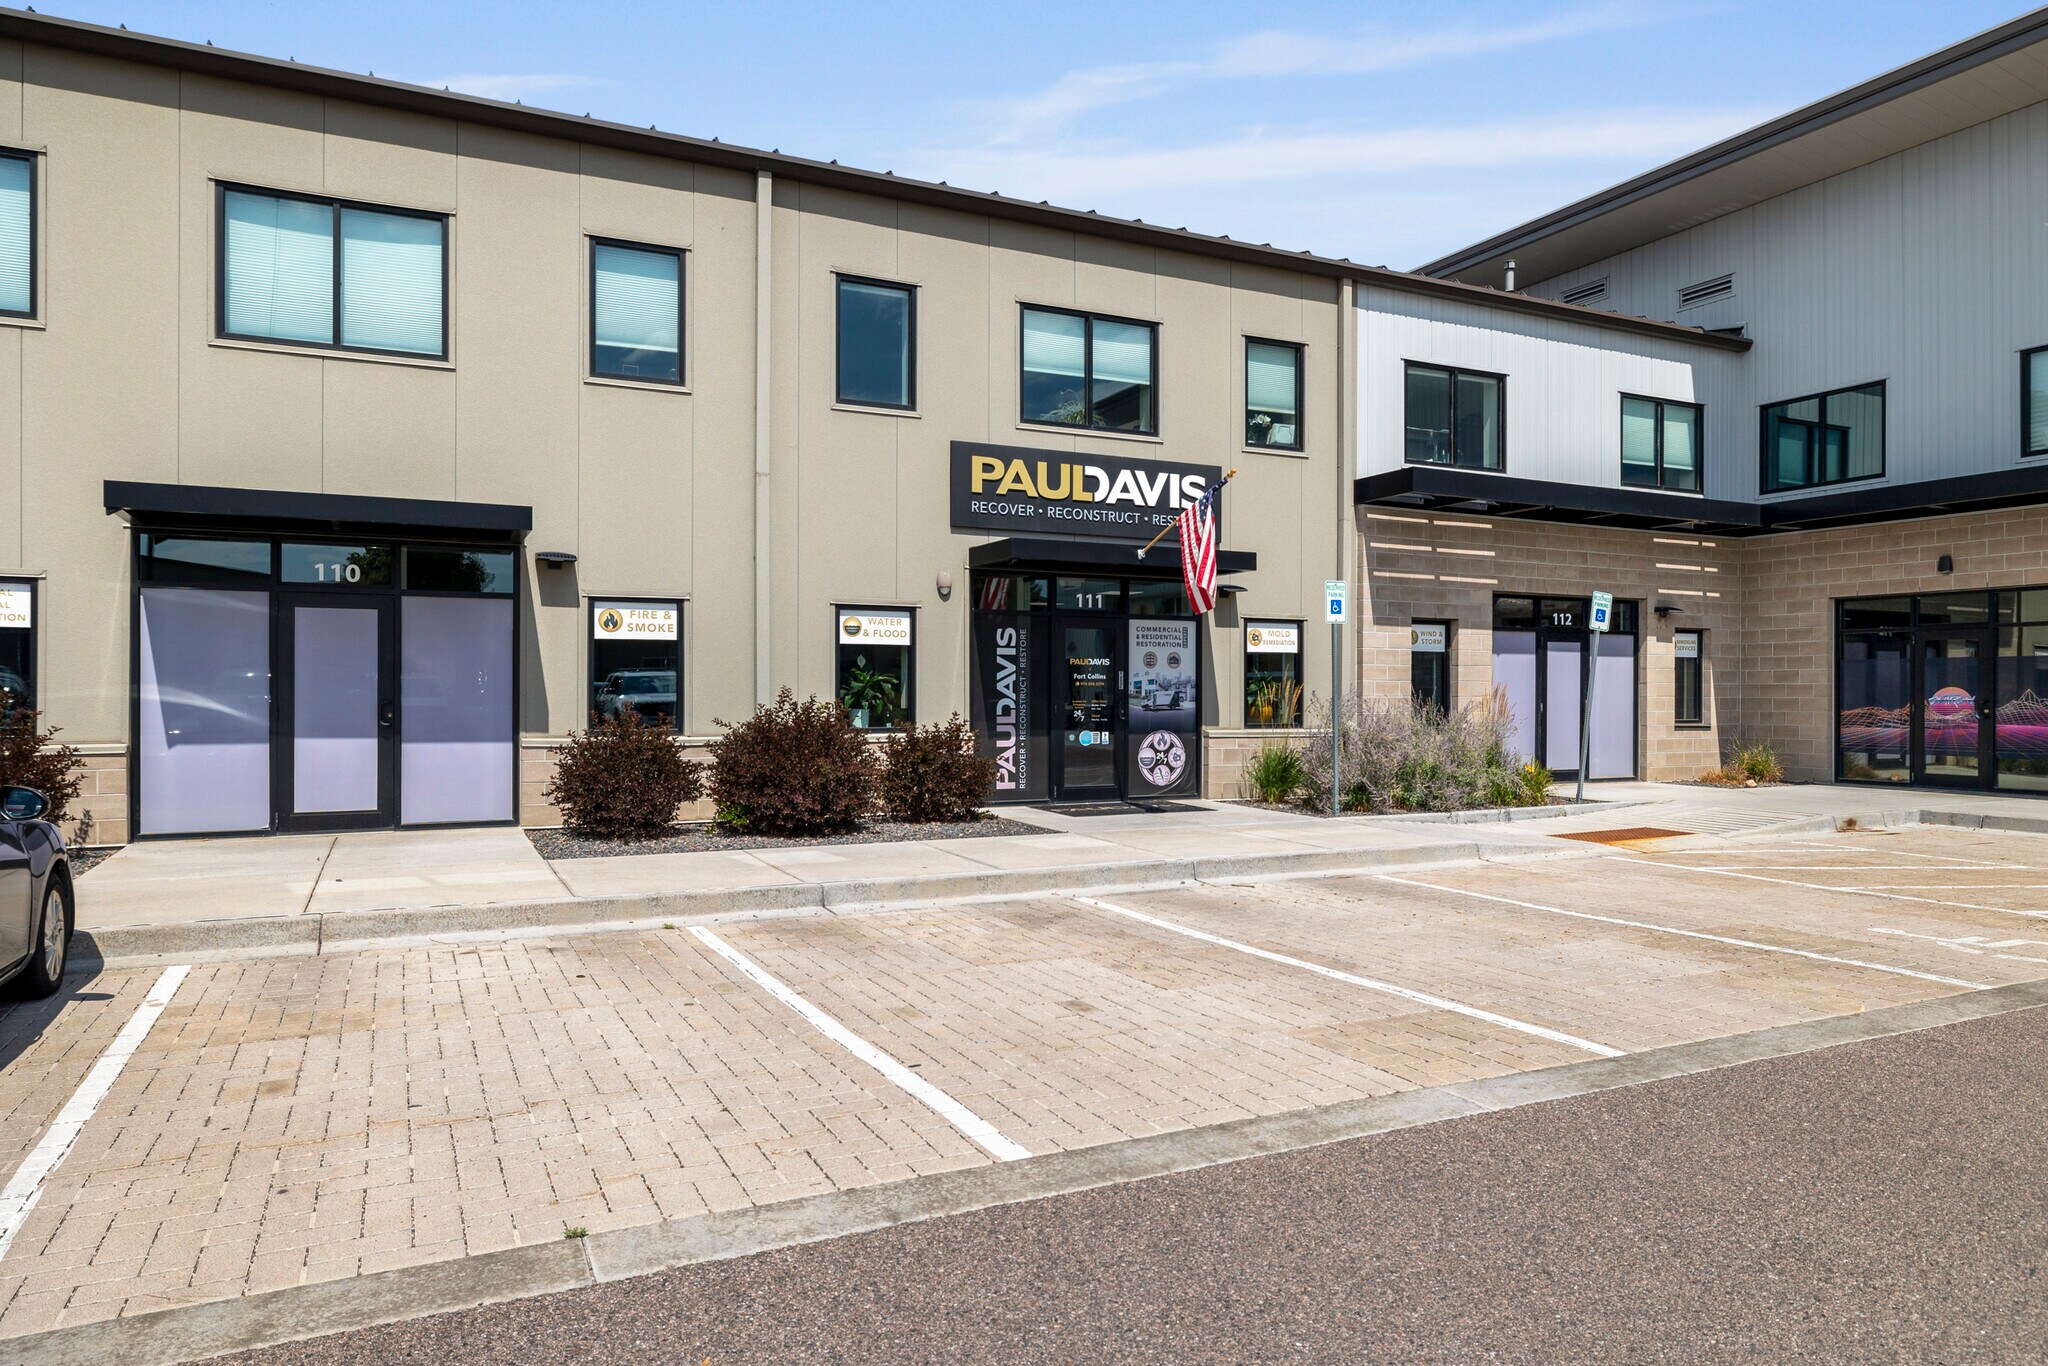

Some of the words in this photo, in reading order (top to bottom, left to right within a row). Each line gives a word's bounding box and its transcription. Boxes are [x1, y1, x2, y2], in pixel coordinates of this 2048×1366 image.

[971, 501, 1034, 517] RECOVER
[1047, 506, 1141, 524] RECONSTRUCT
[1152, 514, 1179, 527] REST
[314, 563, 361, 583] 110
[1076, 593, 1102, 609] 111
[630, 610, 658, 620] FIRE
[663, 610, 672, 620] &
[1552, 612, 1572, 626] 112
[868, 617, 902, 626] WATER
[627, 623, 674, 633] SMOKE
[862, 628, 869, 637] &
[873, 629, 907, 638] FLOOD
[1141, 633, 1182, 641] RESIDENTIAL
